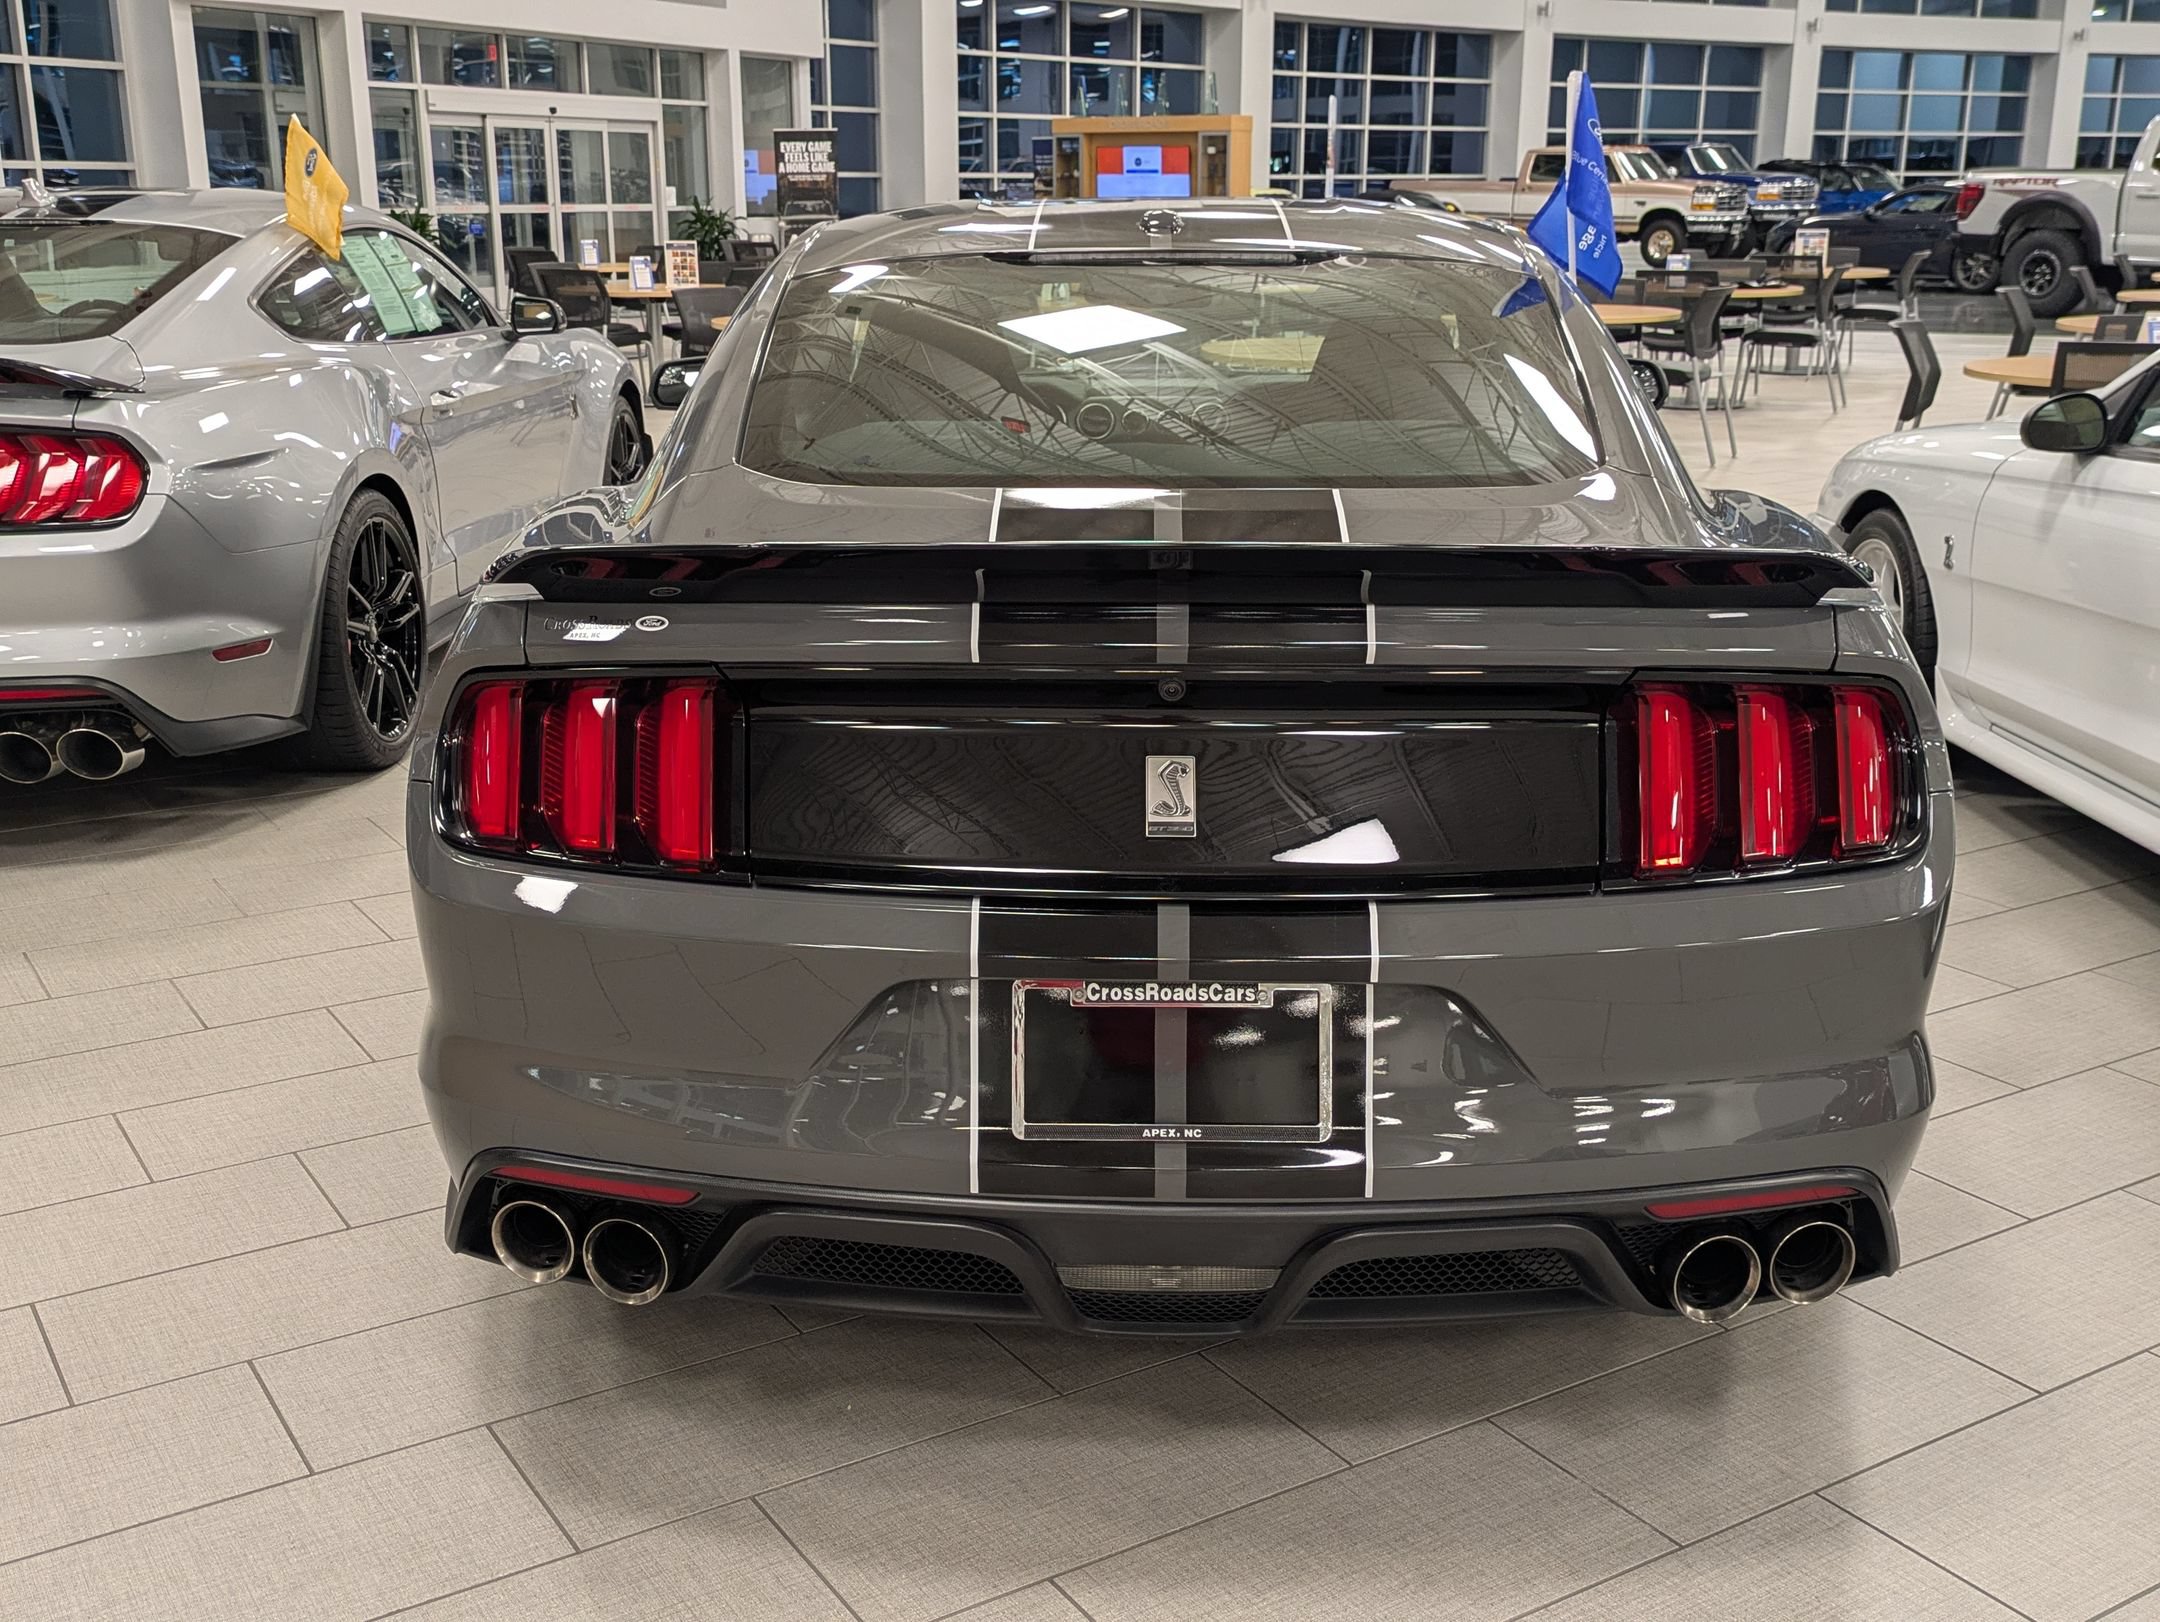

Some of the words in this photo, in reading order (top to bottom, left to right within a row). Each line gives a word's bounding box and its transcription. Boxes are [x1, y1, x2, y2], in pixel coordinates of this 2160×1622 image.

[780, 141, 807, 153] EVERY
[807, 141, 832, 153] GAME
[785, 152, 810, 162] FEELS
[810, 152, 829, 162] LIKE
[779, 161, 786, 173] A
[786, 162, 810, 173] HOME
[811, 161, 836, 173] GAME
[1993, 178, 2059, 187] RAPTOR
[1086, 982, 1256, 1001] CrossRoadsCars
[1142, 1128, 1180, 1138] APEX,
[1184, 1128, 1202, 1138] NC
